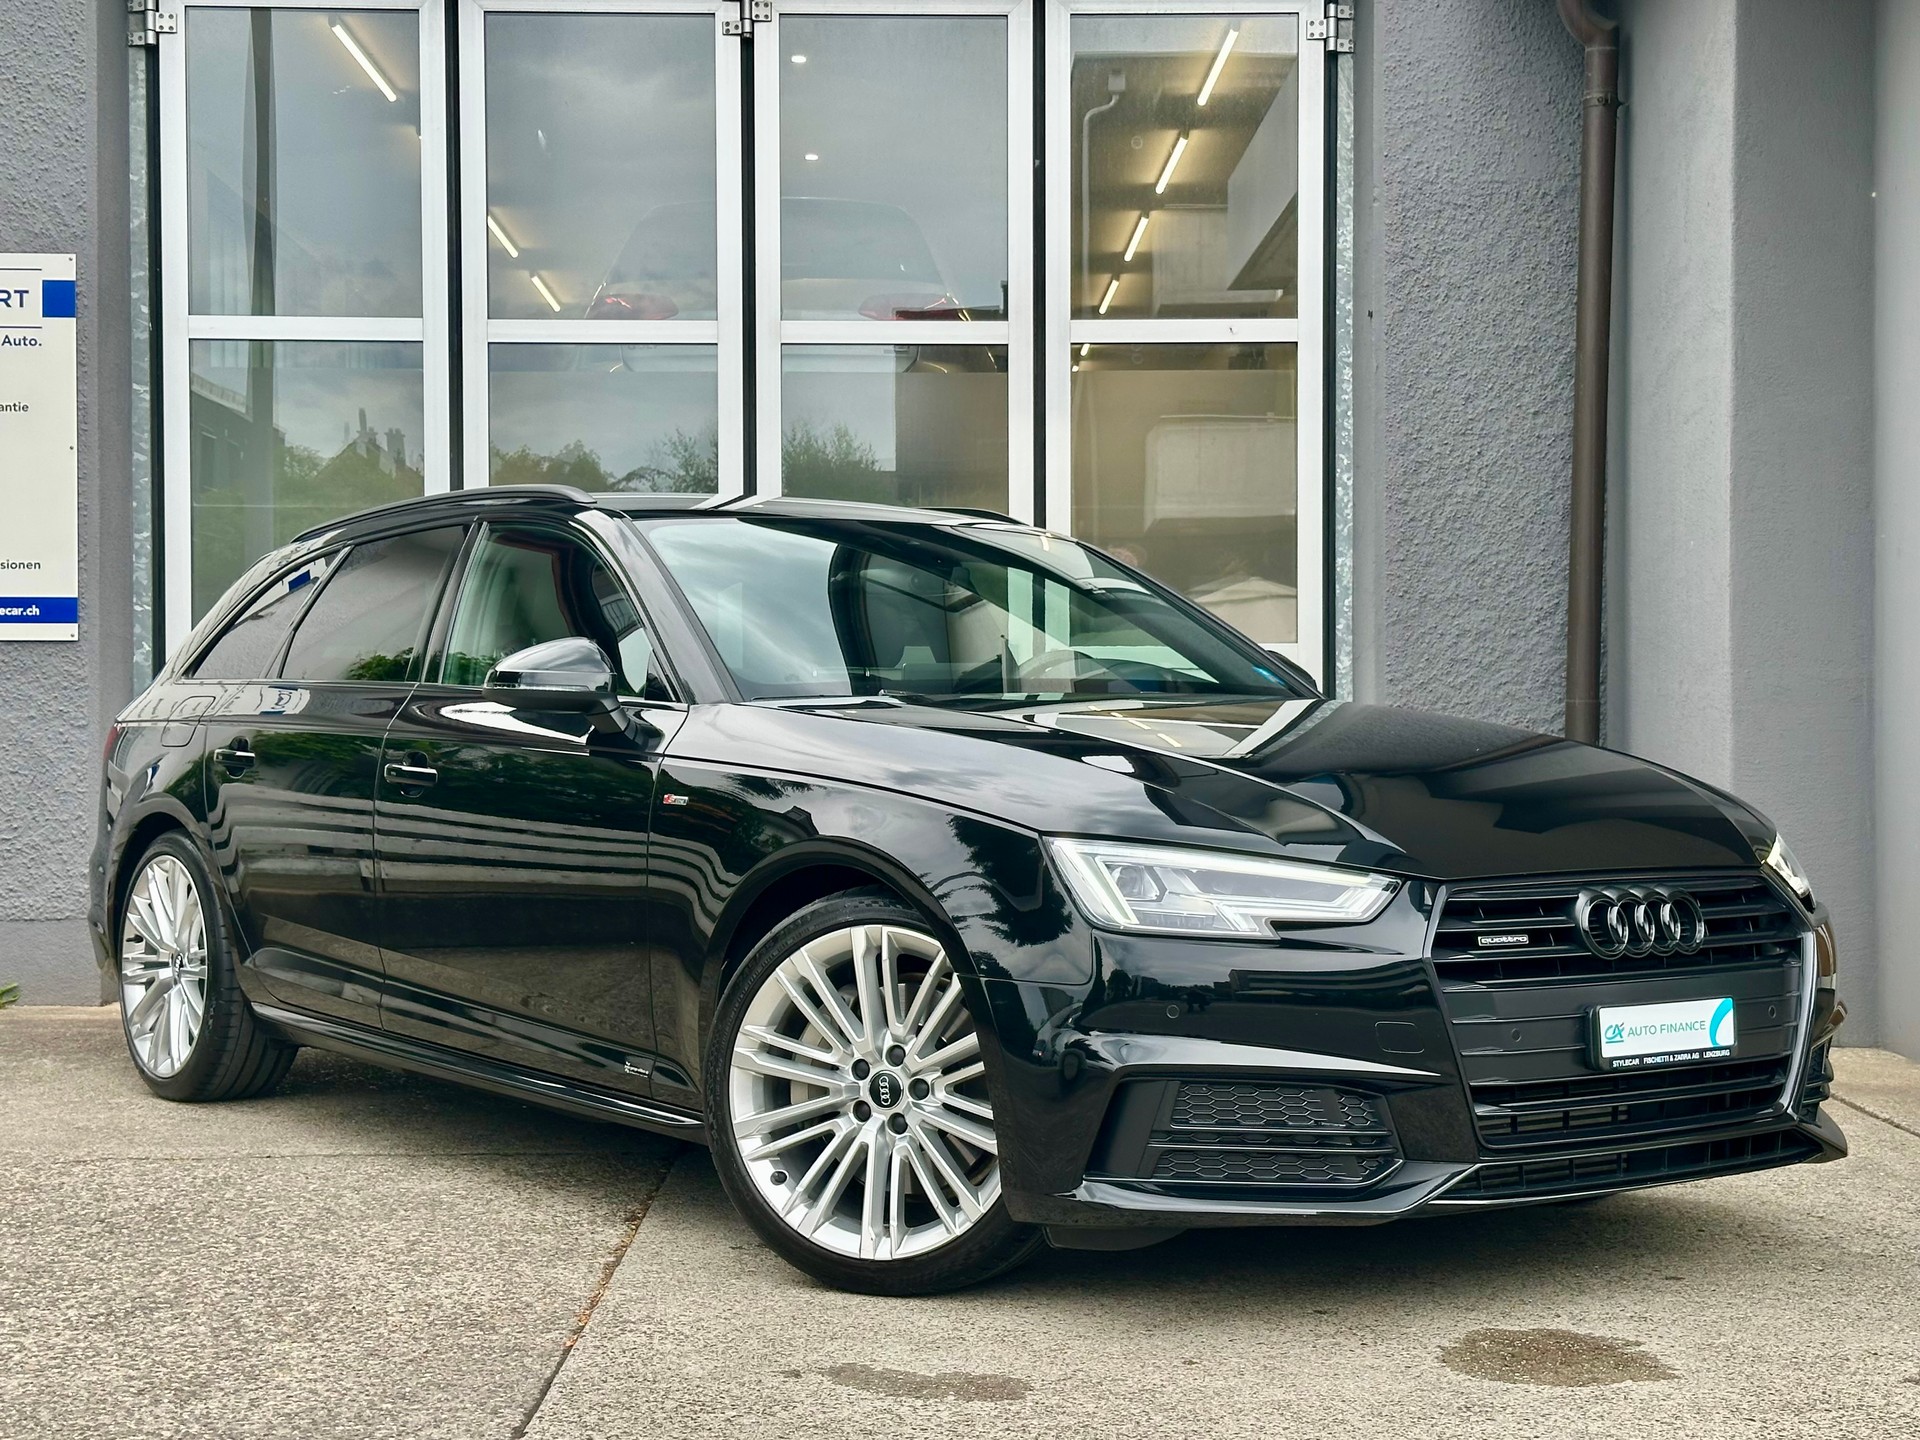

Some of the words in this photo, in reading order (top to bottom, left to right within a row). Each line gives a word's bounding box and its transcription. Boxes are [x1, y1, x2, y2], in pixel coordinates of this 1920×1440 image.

[1, 334, 42, 347] Auto.
[0, 559, 41, 570] sionen
[0, 604, 40, 616] ecar.ch
[1481, 936, 1527, 946] quattro
[1627, 1024, 1657, 1038] AUTO
[1660, 1020, 1706, 1034] FINANCE
[1612, 1058, 1640, 1068] STYLECAR
